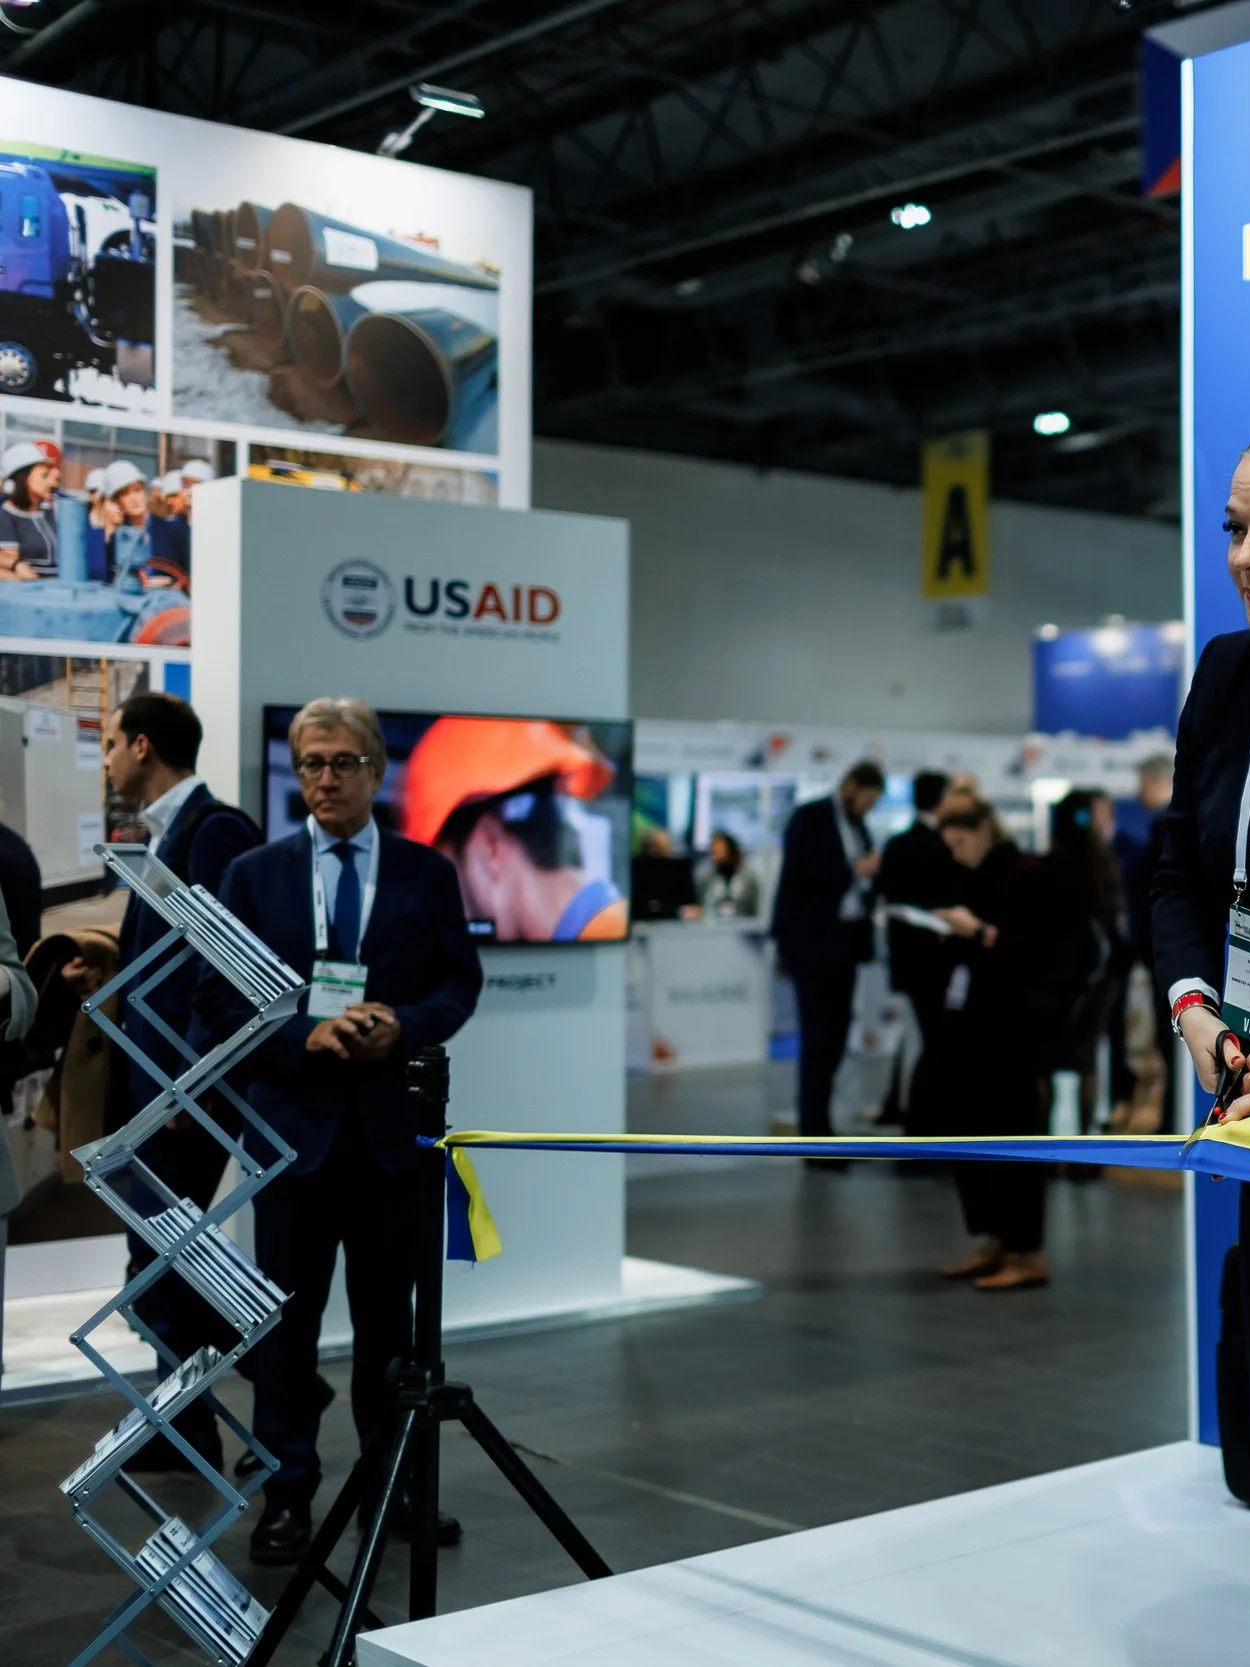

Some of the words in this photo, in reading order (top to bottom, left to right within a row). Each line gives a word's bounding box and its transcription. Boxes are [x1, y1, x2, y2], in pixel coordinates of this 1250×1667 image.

[937, 485, 977, 581] A
[404, 575, 561, 625] USAID
[486, 973, 557, 991] PROJECT
